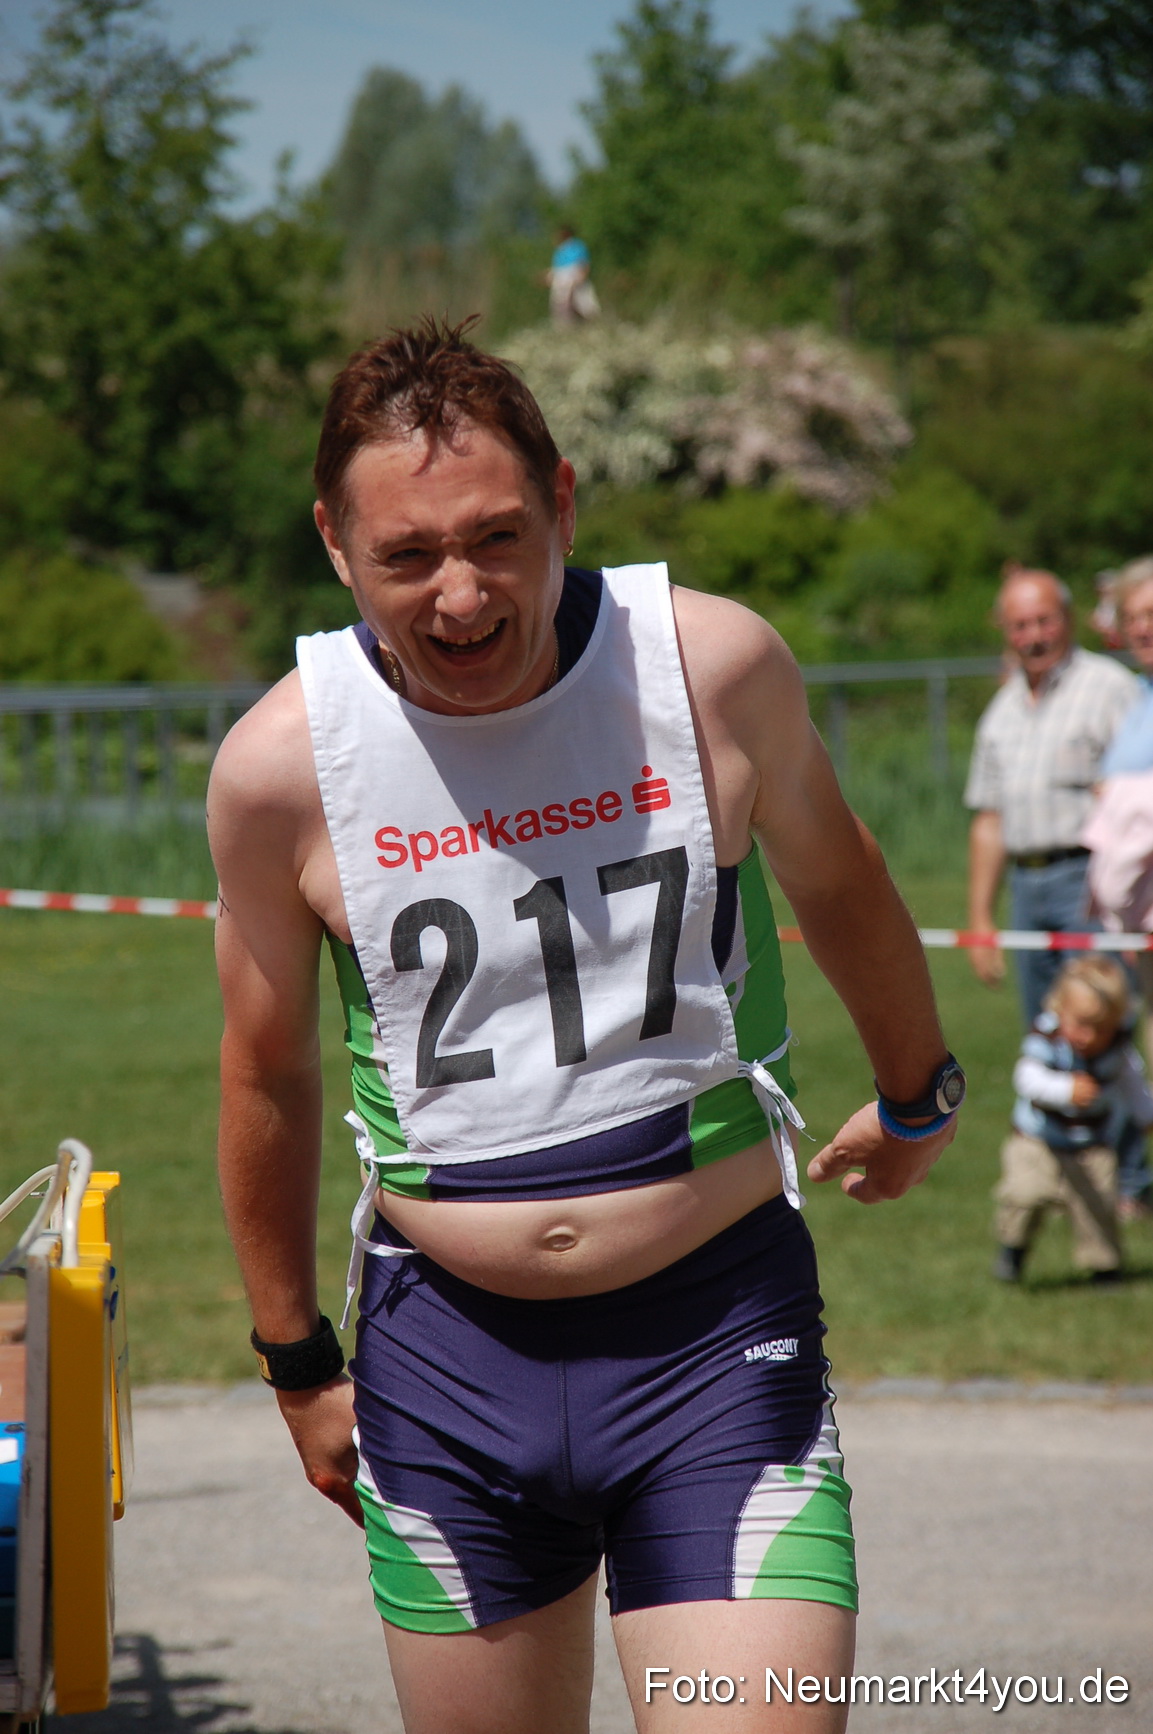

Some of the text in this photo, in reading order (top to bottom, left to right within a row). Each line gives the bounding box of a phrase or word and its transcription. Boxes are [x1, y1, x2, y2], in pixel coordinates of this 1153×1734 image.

[374, 790, 624, 873] Sparkasse
[390, 845, 690, 1089] 217
[744, 1338, 799, 1363] SAUCONY
